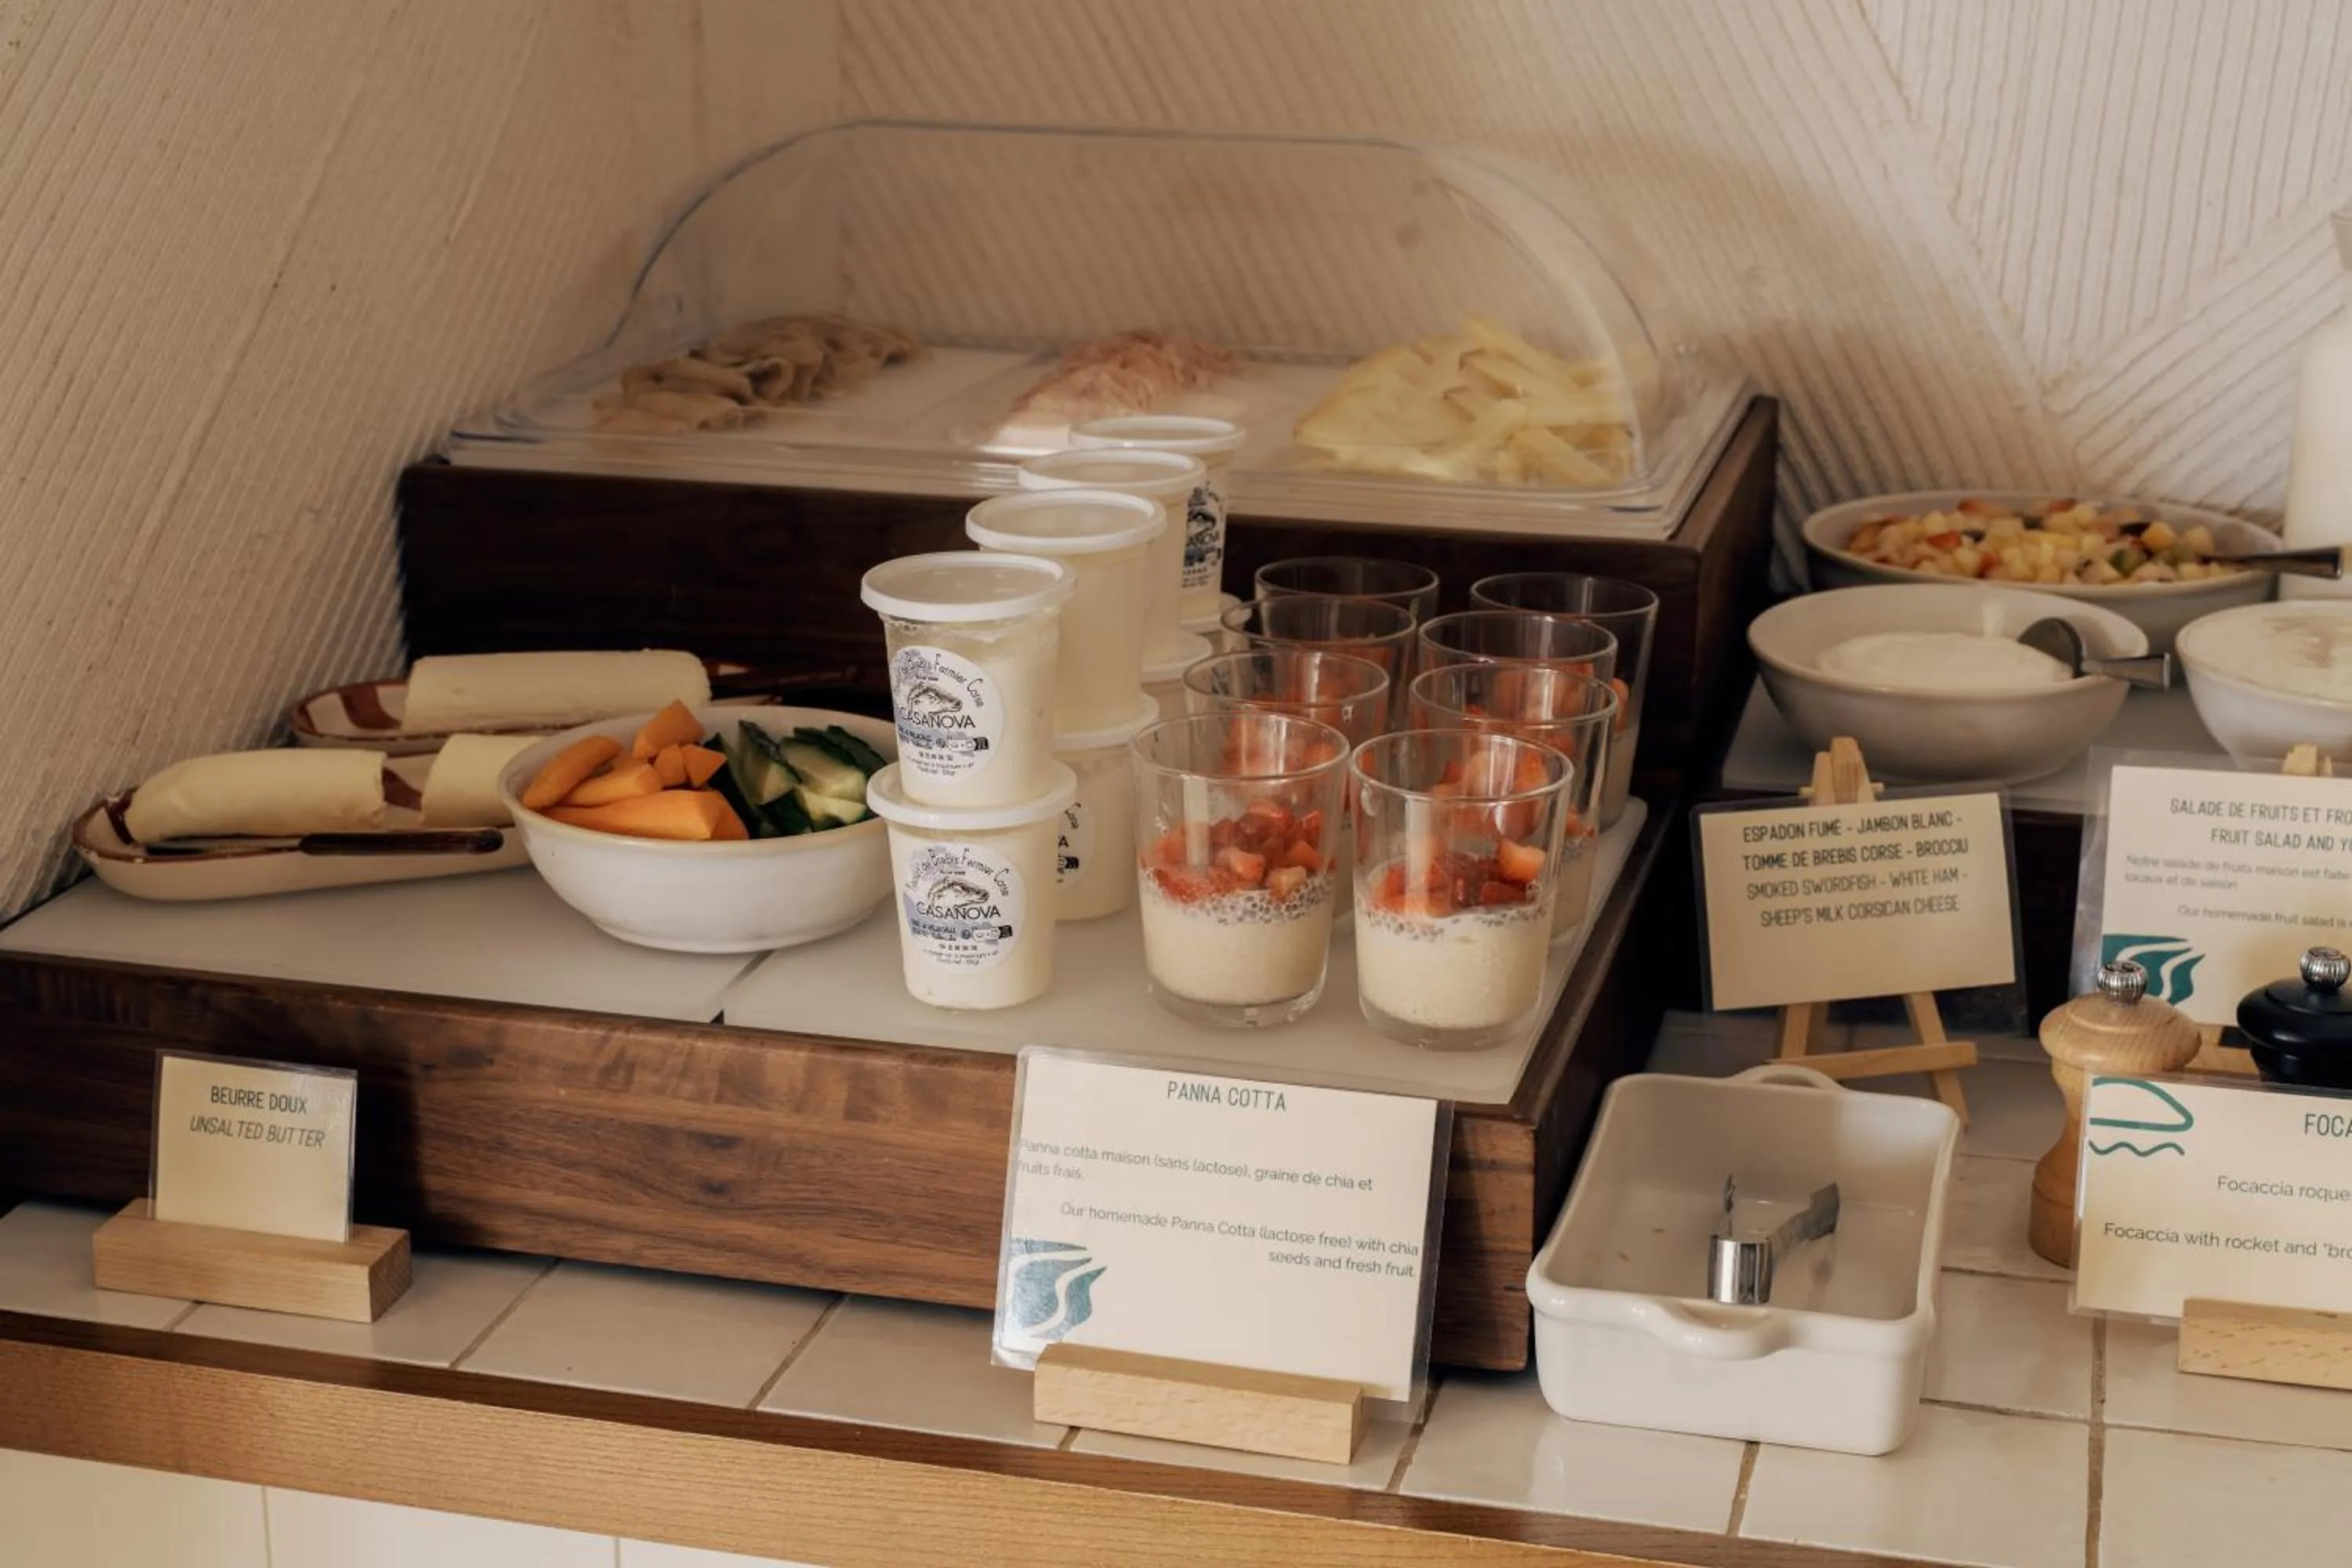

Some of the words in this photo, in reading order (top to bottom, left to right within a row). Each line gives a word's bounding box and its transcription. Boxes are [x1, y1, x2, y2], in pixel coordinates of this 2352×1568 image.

[901, 706, 975, 728] CASANOVA
[2170, 798, 2224, 817] SALADE
[2229, 802, 2245, 818] DE
[2250, 804, 2299, 822] FRUITS
[2303, 807, 2321, 823] ET
[1743, 823, 1806, 843] ESPADON
[1809, 818, 1842, 837] FUMÉ
[1857, 815, 1908, 833] JAMBON
[1911, 811, 1953, 829] BLANC
[2211, 828, 2250, 845] FRUIT
[2256, 831, 2301, 849] SALAD
[2307, 835, 2334, 851] AND
[1743, 853, 1788, 870] TOMME
[1792, 851, 1809, 867] DE
[1813, 847, 1857, 866] BREBIS
[1860, 844, 1903, 862] CORSE
[1916, 838, 1969, 858] BROCCIU
[2205, 858, 2220, 870] de
[2223, 860, 2252, 873] fruits
[1747, 880, 1798, 900] SMOKED
[1803, 874, 1876, 895] SWORDFISH
[1889, 869, 1929, 888] WHITE
[1933, 867, 1958, 884] HAM
[916, 902, 1000, 920] CASANOVA
[1761, 907, 1813, 927] SHEEP'S
[1817, 905, 1843, 923] MILK
[1848, 900, 1910, 920] CORSICAN
[1915, 895, 1959, 915] CHEESE
[2177, 904, 2199, 916] Our
[2202, 907, 2271, 923] homemade
[2274, 911, 2298, 924] fruit
[2302, 914, 2334, 927] salad
[211, 1086, 265, 1109] BEURRE
[269, 1093, 308, 1114] DOUX
[1167, 1080, 1221, 1104] PANNA
[1229, 1087, 1287, 1111] COTTA
[191, 1116, 263, 1139] UNSALTED
[267, 1125, 325, 1149] BUTTER
[1064, 1145, 1098, 1160] cotta
[1102, 1149, 1150, 1166] maison
[1154, 1154, 1189, 1171] (sans
[1254, 1167, 1298, 1184] graine
[1302, 1171, 1321, 1185] de
[1324, 1174, 1354, 1189] chia
[1358, 1179, 1372, 1191] et
[2217, 1175, 2294, 1197] Focaccia
[1061, 1201, 1084, 1216] Our
[1089, 1206, 1167, 1228] homemade
[1171, 1216, 1214, 1232] Panna
[1218, 1221, 1255, 1237] Cotta
[1258, 1227, 1315, 1244] (lactose
[1319, 1231, 1352, 1249] free)
[1356, 1238, 1385, 1253] with
[1389, 1241, 1418, 1256] chia
[2103, 1222, 2179, 1243] Focaccia
[2184, 1232, 2220, 1248] with
[2224, 1236, 2279, 1254] rocket
[2284, 1241, 2317, 1256] and
[1269, 1250, 1310, 1266] seeds
[1315, 1255, 1341, 1269] and
[1346, 1258, 1381, 1275] fresh
